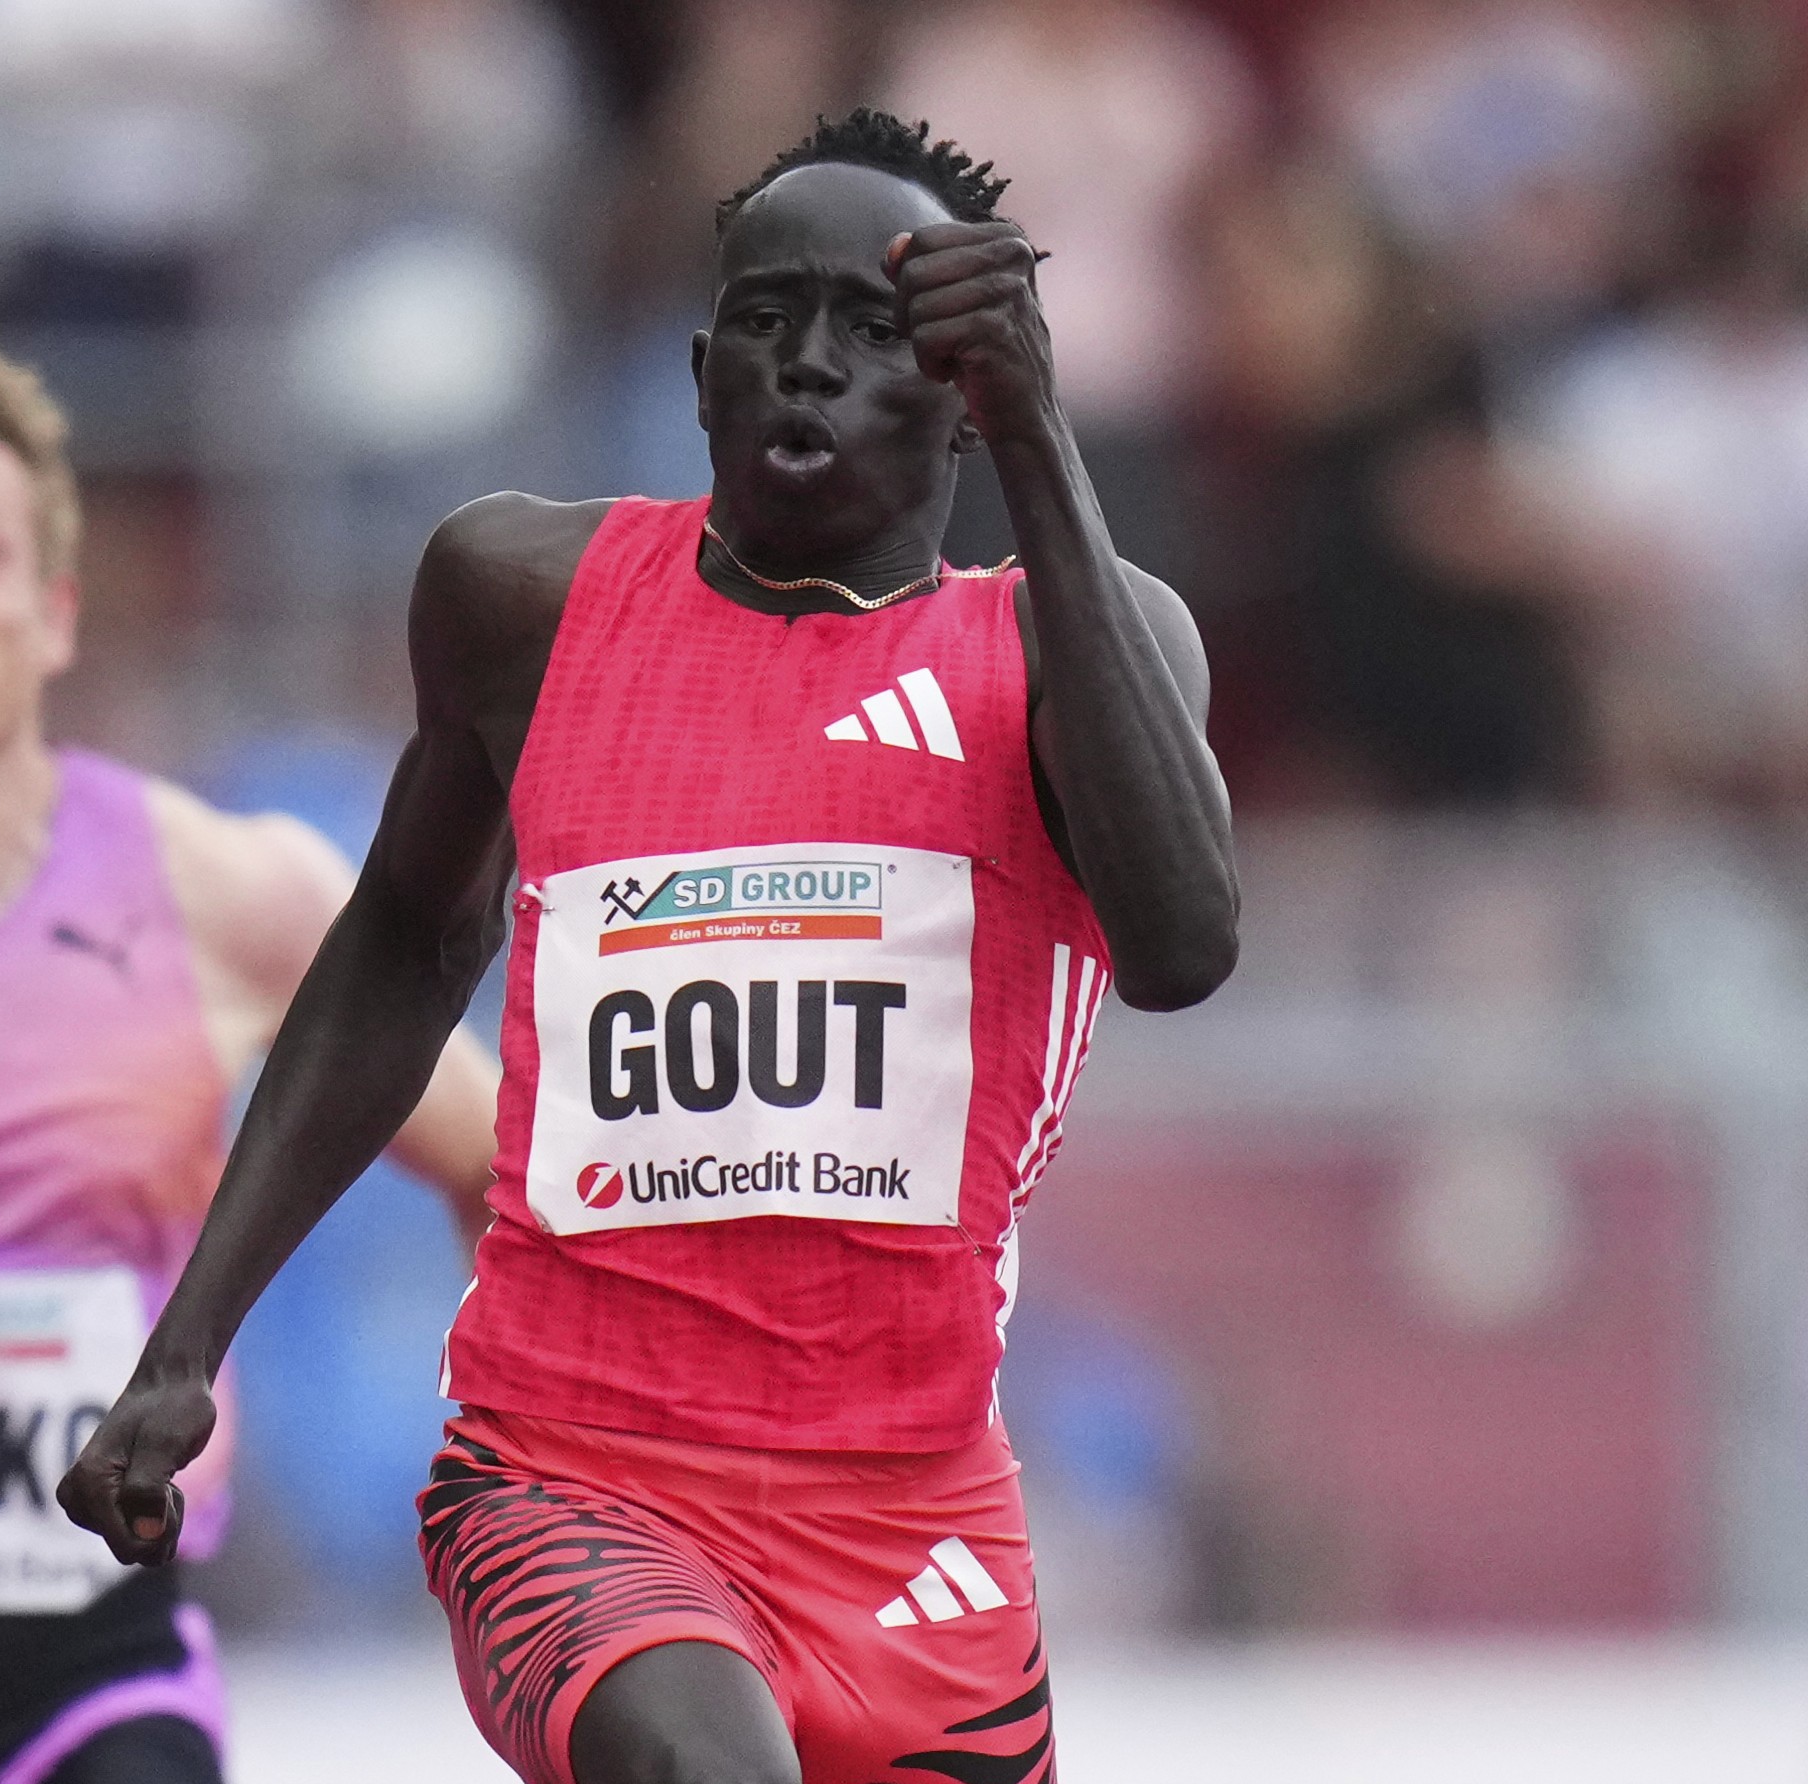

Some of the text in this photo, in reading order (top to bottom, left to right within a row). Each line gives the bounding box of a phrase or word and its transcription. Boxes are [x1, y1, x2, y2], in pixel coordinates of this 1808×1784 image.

[673, 870, 871, 908] SD GROUP
[670, 919, 801, 941] člen Skupiny ČEZ
[588, 979, 907, 1121] GOUT
[628, 1151, 911, 1202] UniCredit Bank
